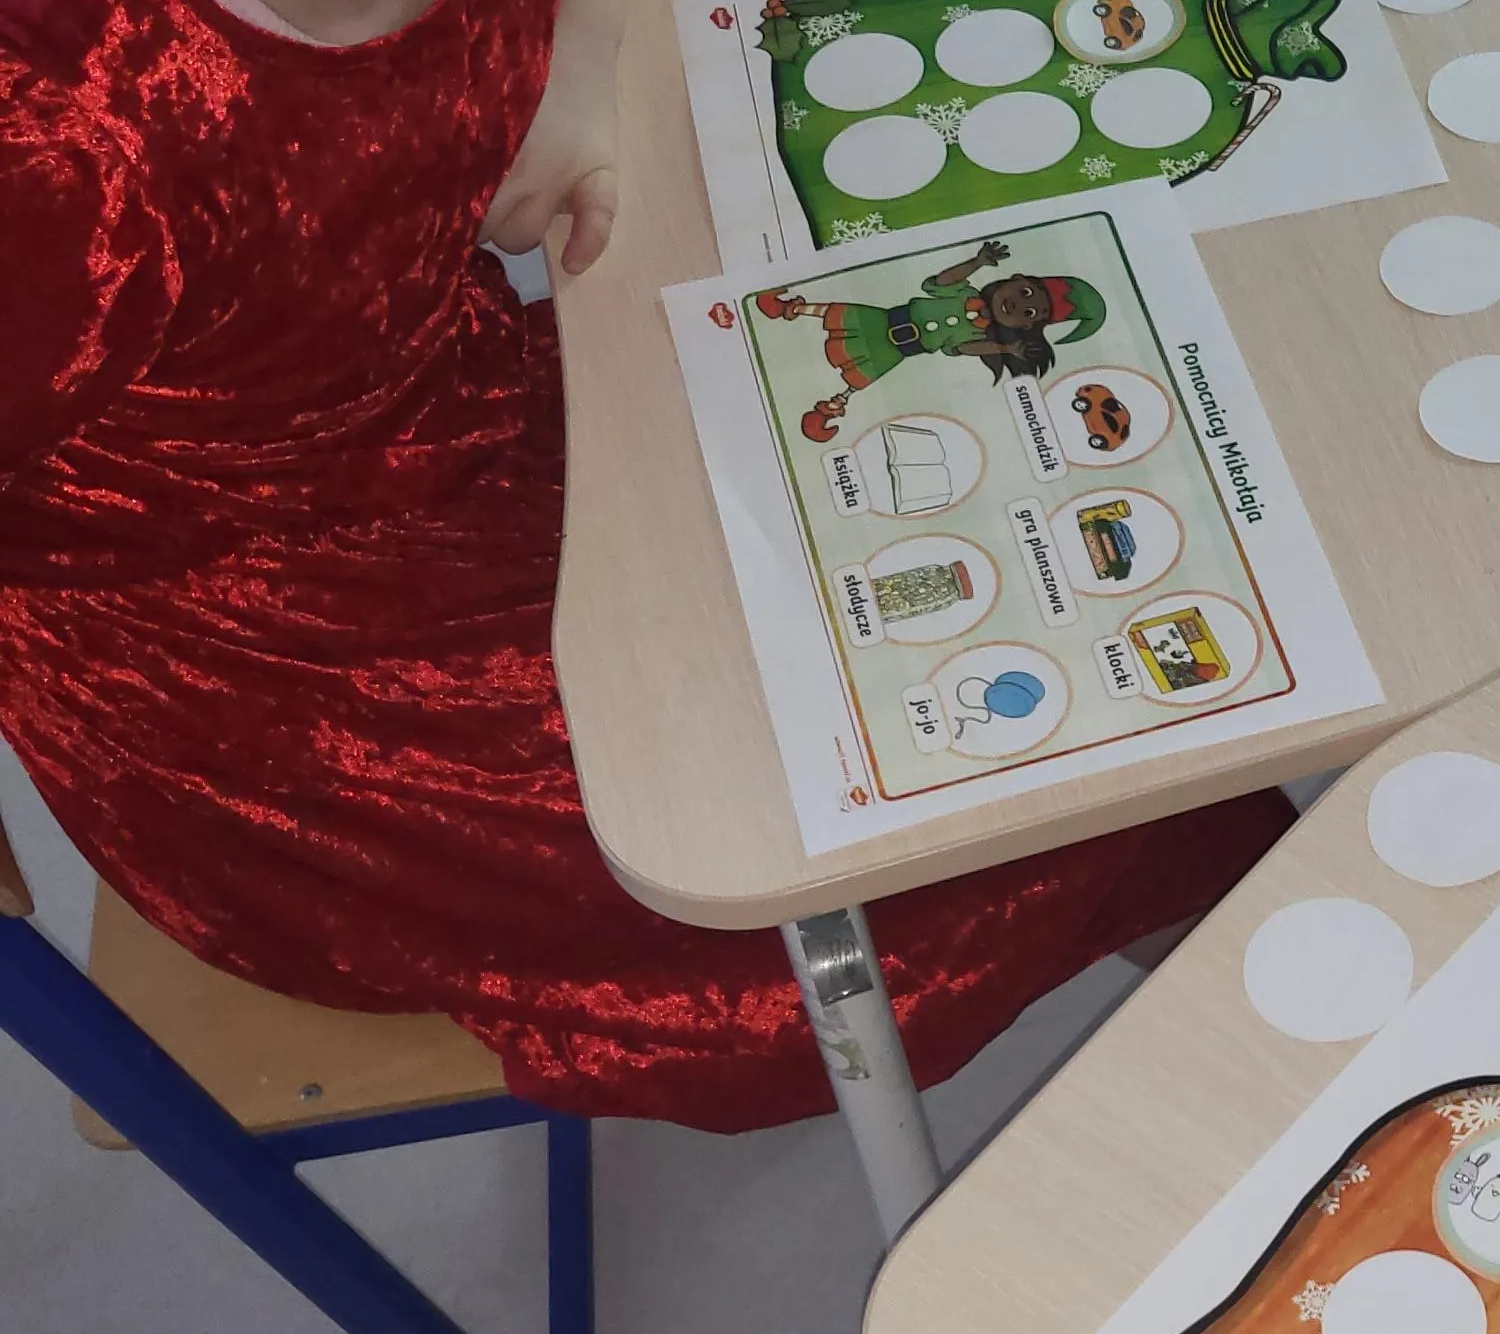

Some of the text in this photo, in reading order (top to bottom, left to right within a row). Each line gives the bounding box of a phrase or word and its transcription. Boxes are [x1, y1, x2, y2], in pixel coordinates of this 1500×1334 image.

[1015, 384, 1059, 472] samochodzik
[1177, 342, 1264, 524] Pomocnicy Mikołaja
[832, 454, 858, 509] książka
[1015, 509, 1066, 615] gra planszowa
[843, 573, 871, 638] słodycze
[1103, 643, 1135, 690] klocki
[909, 698, 935, 735] jo-jo
